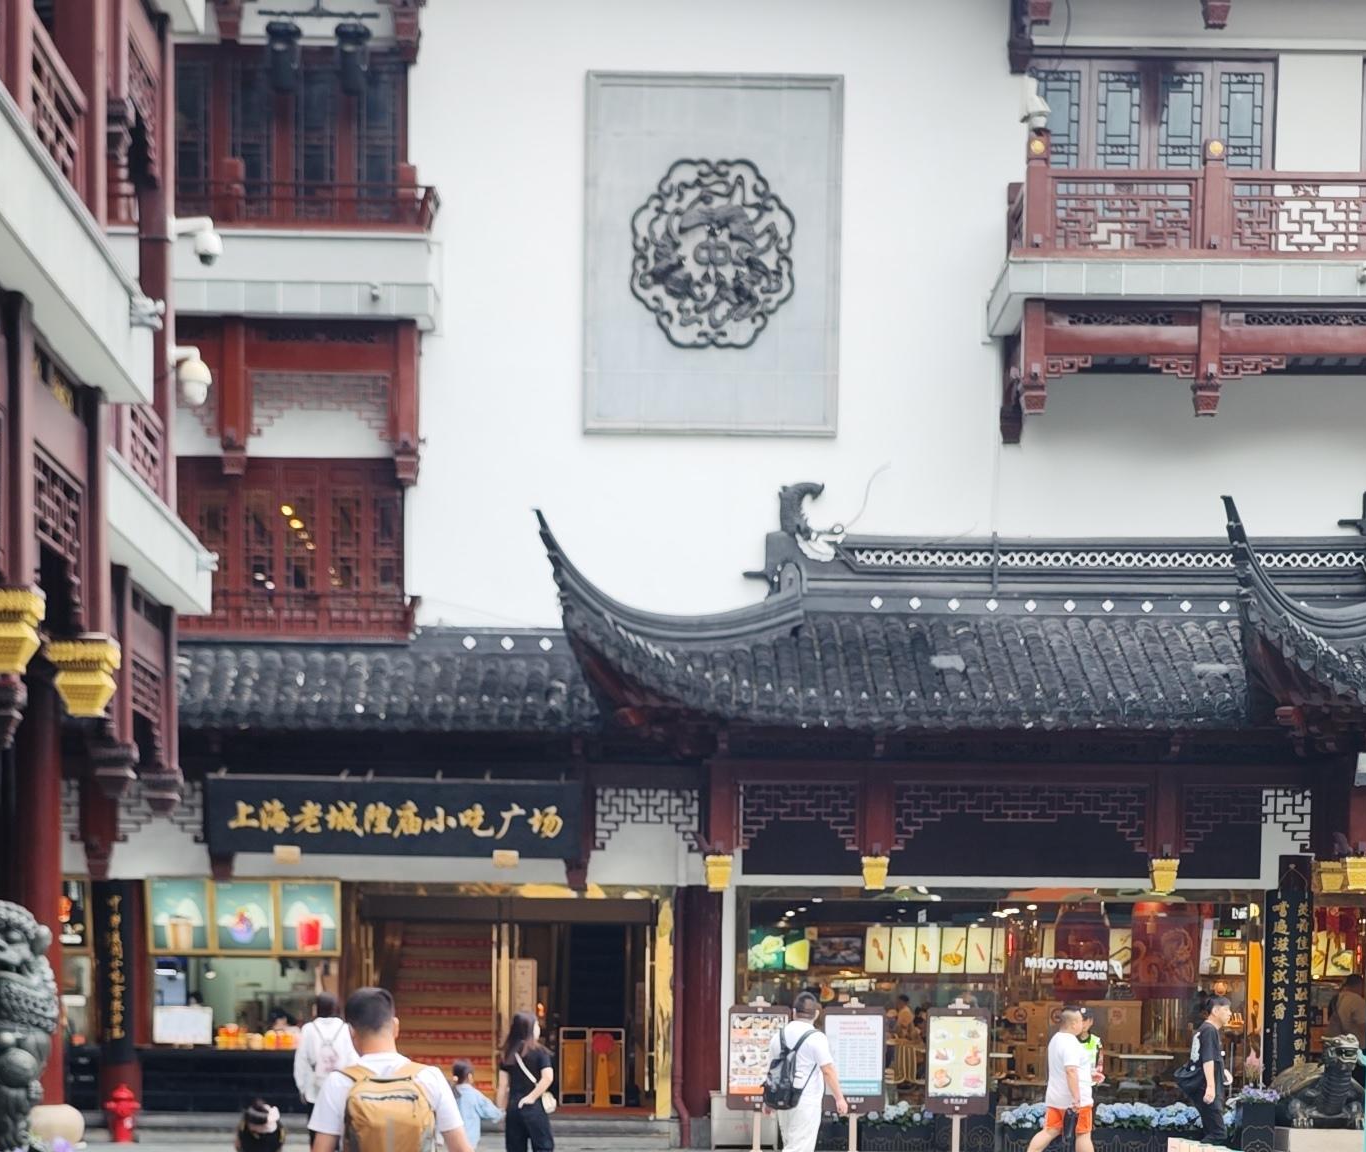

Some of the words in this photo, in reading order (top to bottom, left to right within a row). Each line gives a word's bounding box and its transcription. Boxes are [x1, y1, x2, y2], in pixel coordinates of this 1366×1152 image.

[227, 799, 565, 839] 上海老城隍庙小吃广场
